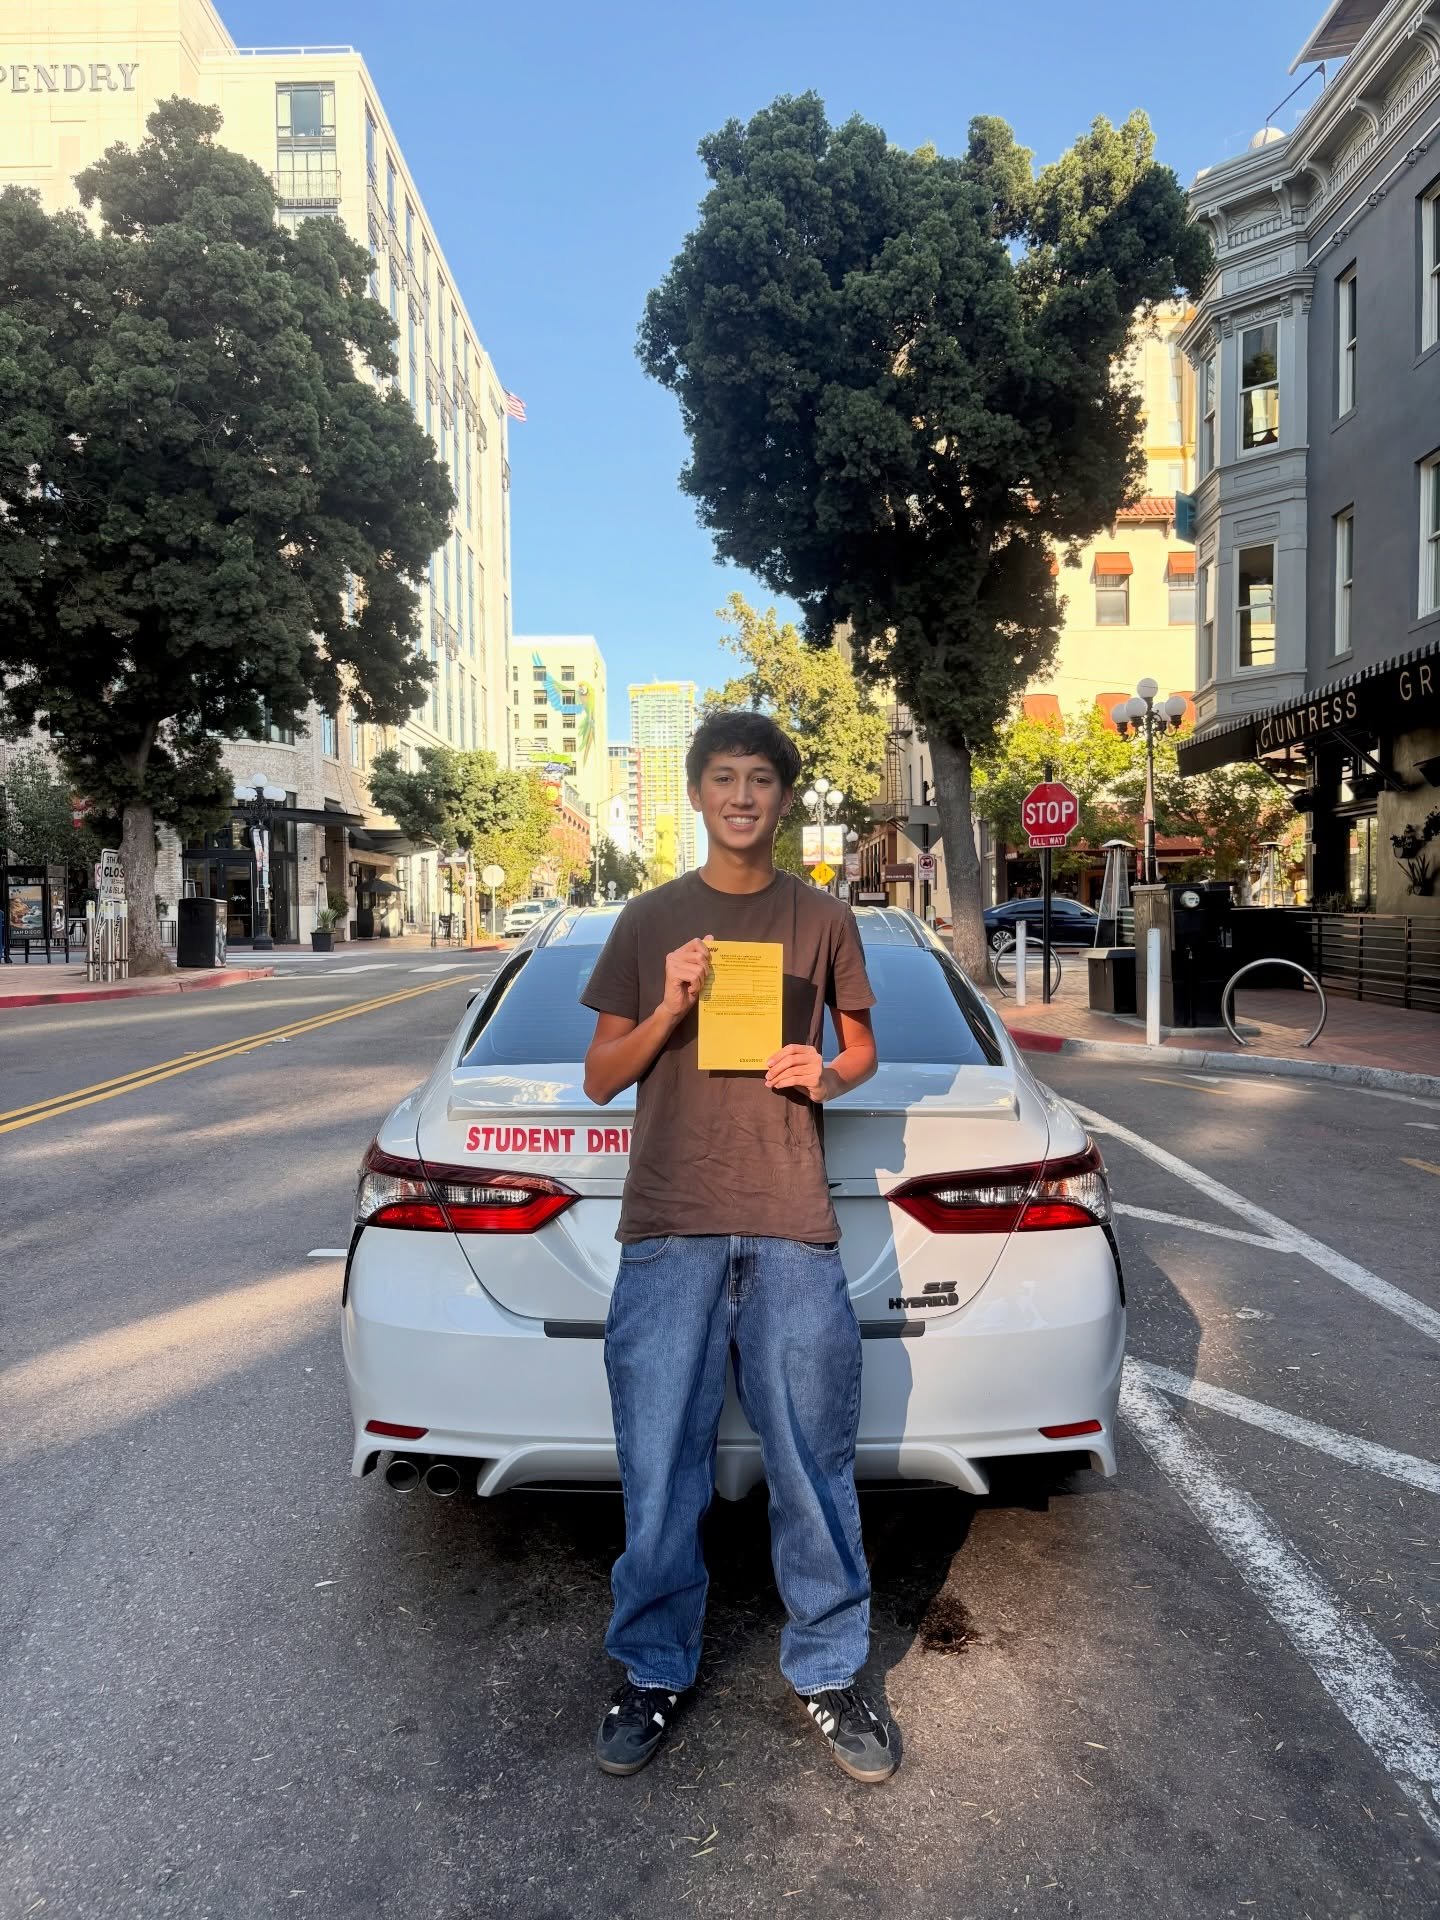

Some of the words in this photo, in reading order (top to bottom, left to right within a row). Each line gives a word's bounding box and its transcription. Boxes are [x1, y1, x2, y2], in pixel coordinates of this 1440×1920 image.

[1025, 801, 1074, 825] STOP
[1032, 838, 1046, 846] ALL
[1049, 836, 1063, 845] WAY
[466, 1126, 575, 1153] STUDENT
[587, 1128, 633, 1153] DRI
[922, 1280, 958, 1294] SE
[888, 1295, 948, 1310] HYBRID
